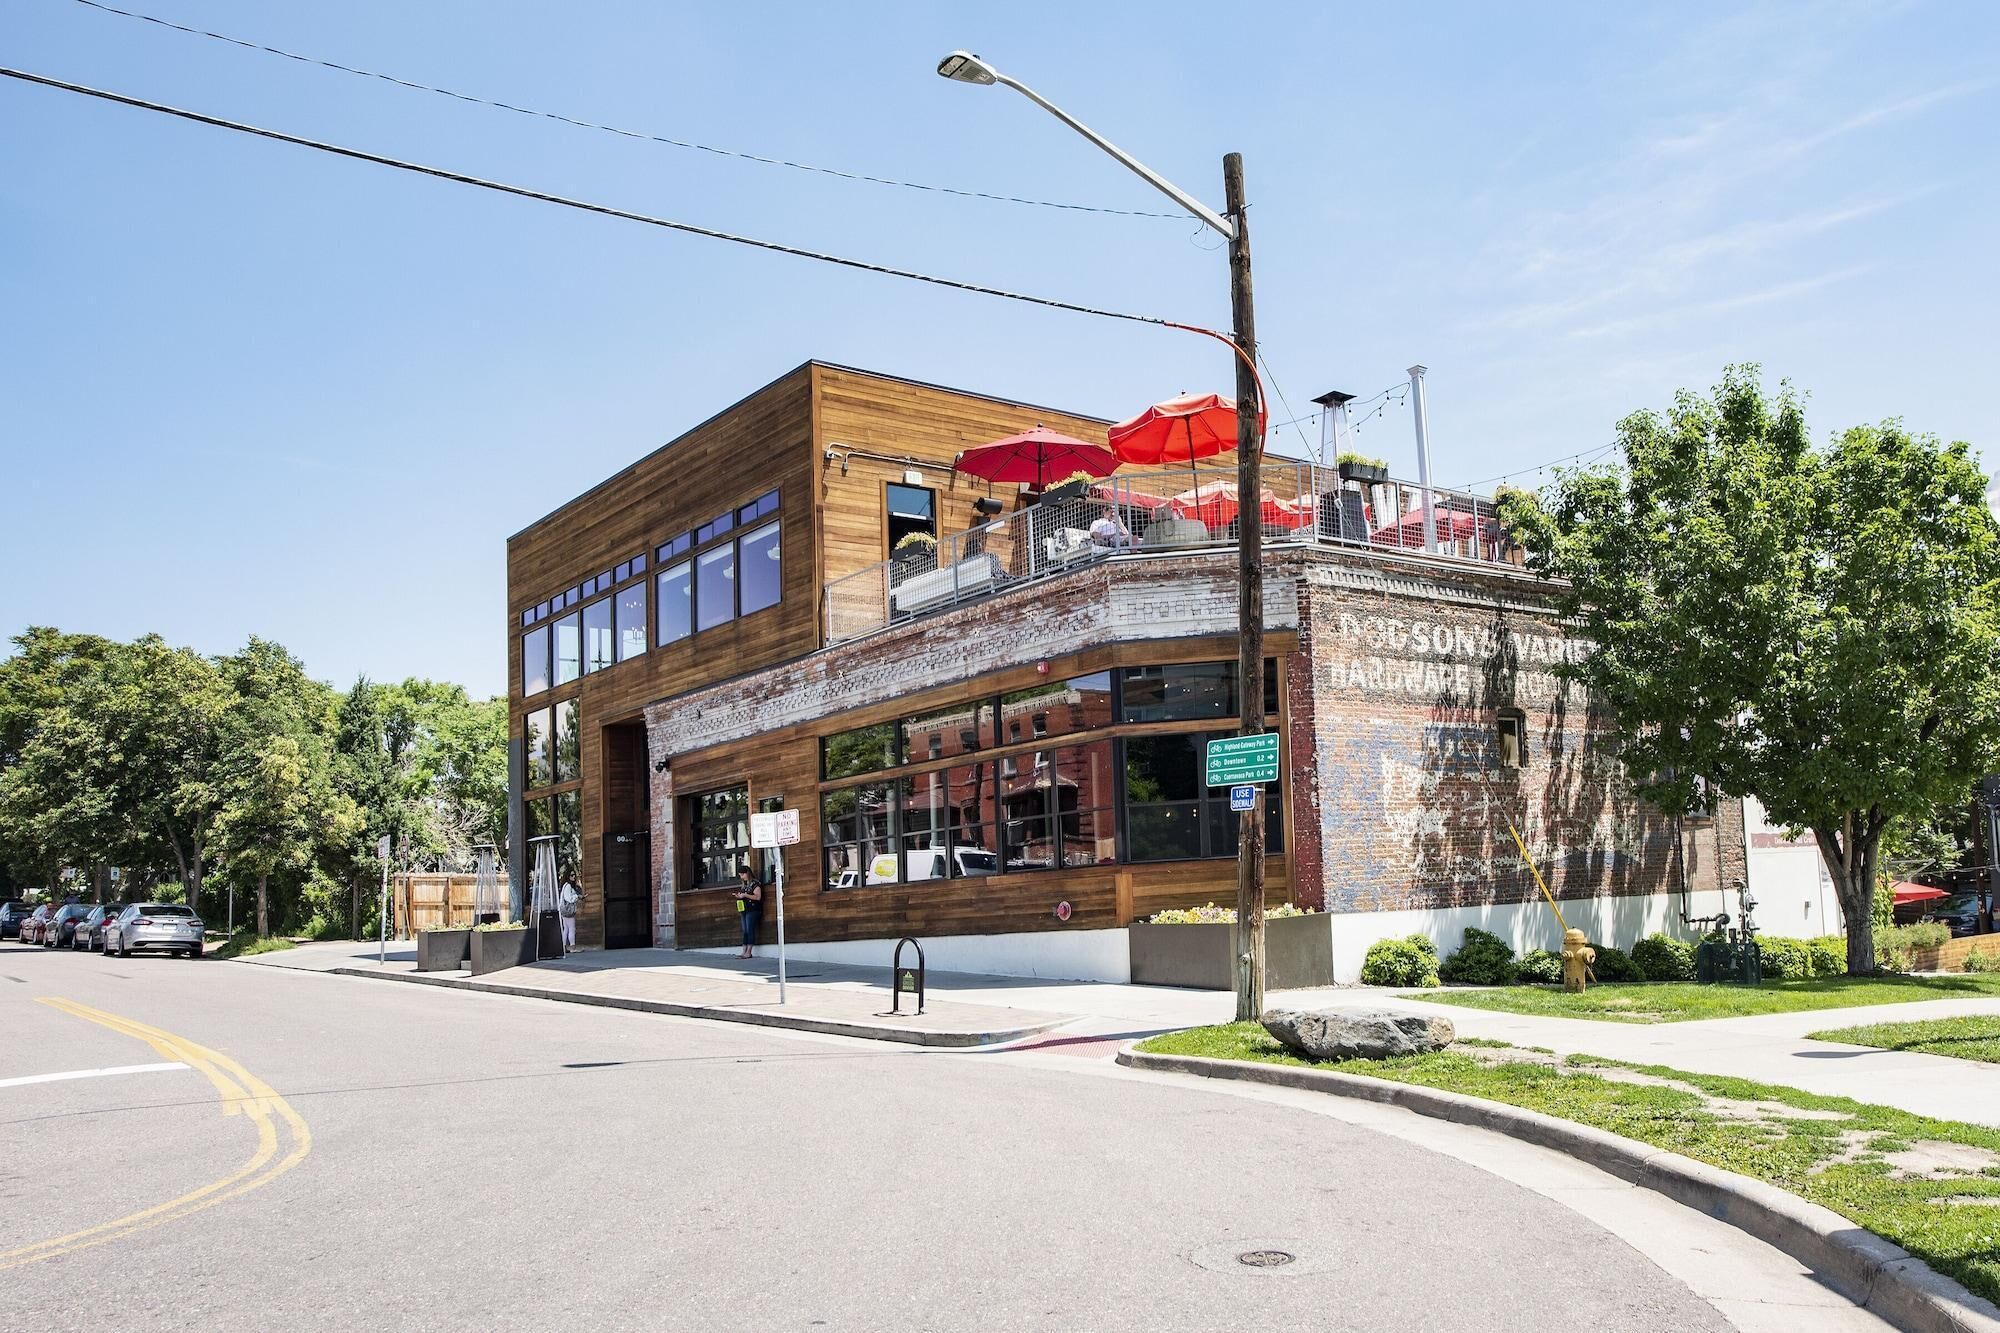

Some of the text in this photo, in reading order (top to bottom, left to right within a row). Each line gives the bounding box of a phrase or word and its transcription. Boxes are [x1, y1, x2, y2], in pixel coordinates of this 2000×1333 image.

[1224, 743, 1240, 751] Highland
[1236, 789, 1249, 797] USE
[1233, 799, 1253, 808] SIDEWALK
